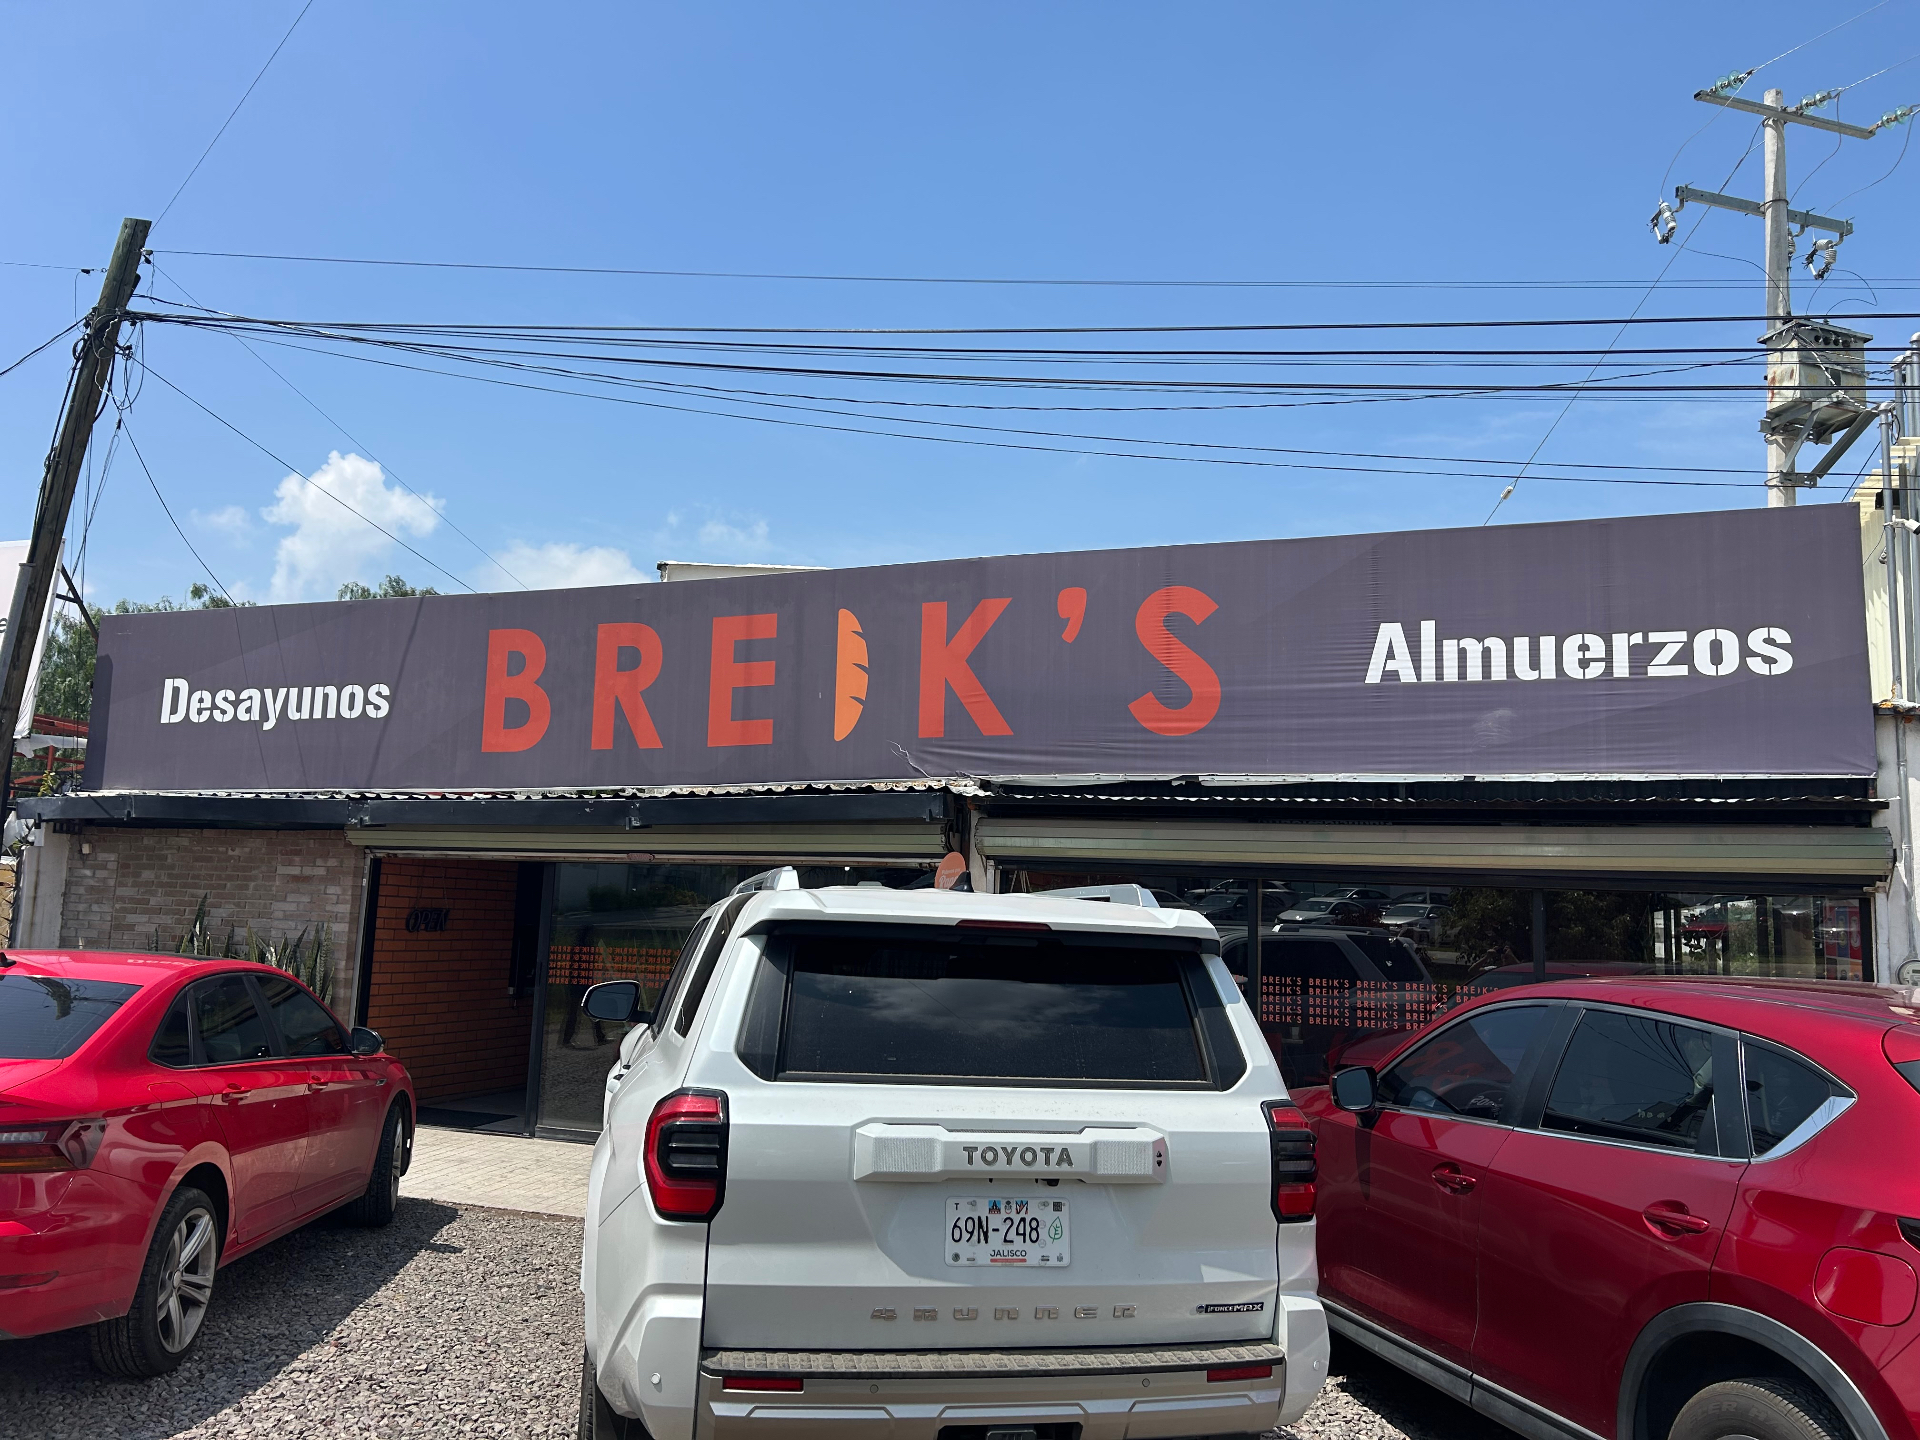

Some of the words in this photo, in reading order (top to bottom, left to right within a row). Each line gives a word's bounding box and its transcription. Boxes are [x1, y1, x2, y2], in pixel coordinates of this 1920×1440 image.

[1364, 619, 1794, 684] Almuerzos
[161, 678, 390, 731] Desayunos
[406, 908, 449, 932] OPEN
[962, 1146, 1074, 1167] TOYOTA
[951, 1215, 1040, 1244] 69N-248
[990, 1249, 1027, 1257] JALISCO
